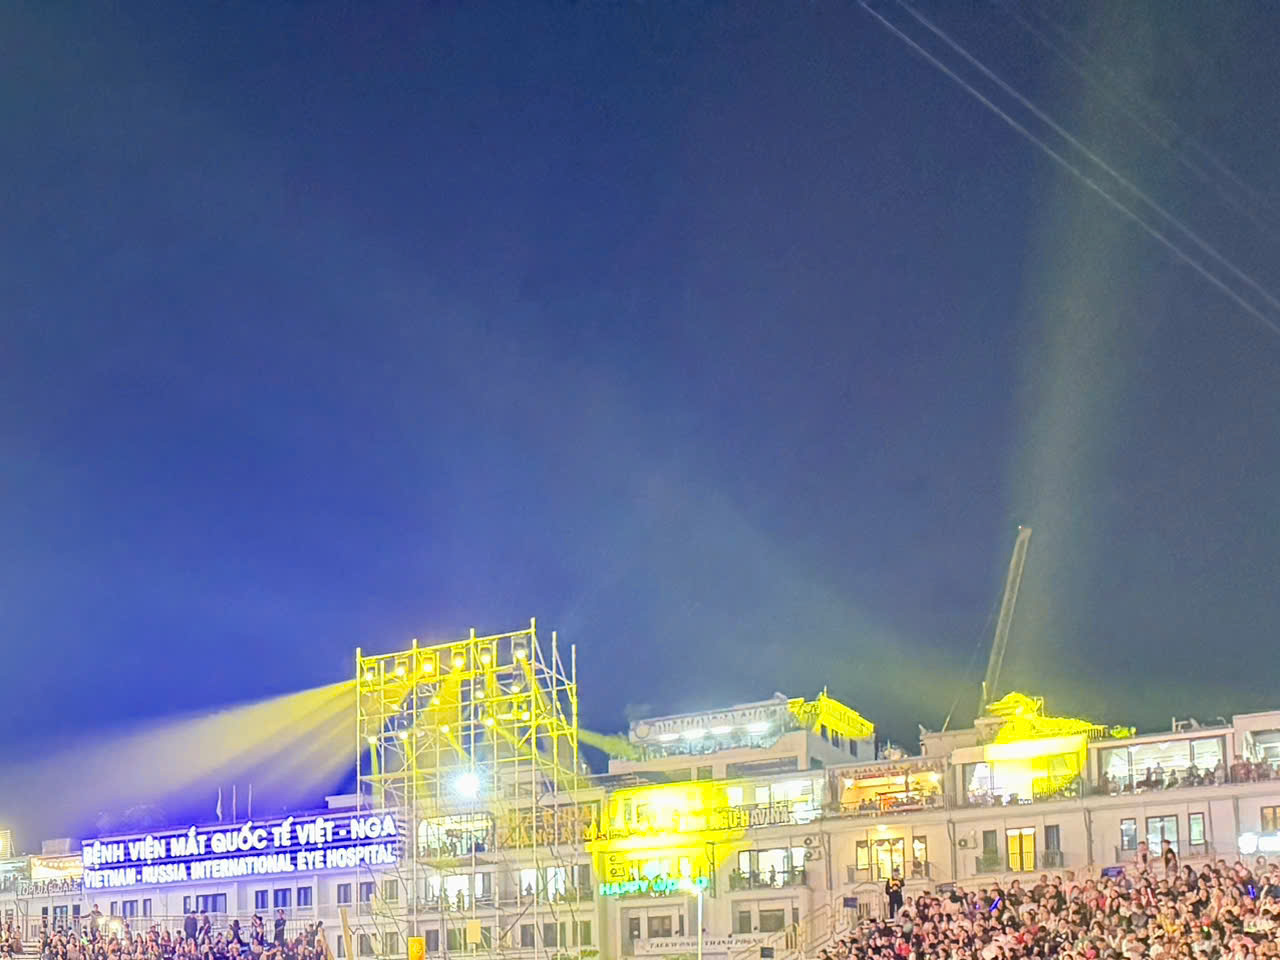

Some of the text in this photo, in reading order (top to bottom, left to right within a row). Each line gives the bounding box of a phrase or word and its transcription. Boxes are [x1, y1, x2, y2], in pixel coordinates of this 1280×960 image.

[83, 840, 124, 869] BỆNH
[128, 835, 166, 864] VIỆN
[170, 826, 207, 856] MẮT
[211, 821, 267, 853] QUỐC
[272, 816, 294, 847] TẾ
[296, 817, 335, 848] VIỆT
[350, 815, 397, 839] NGA
[191, 853, 295, 880] INTERNATIONAL
[297, 850, 324, 870] EYE
[327, 844, 397, 868] HOSPITAL
